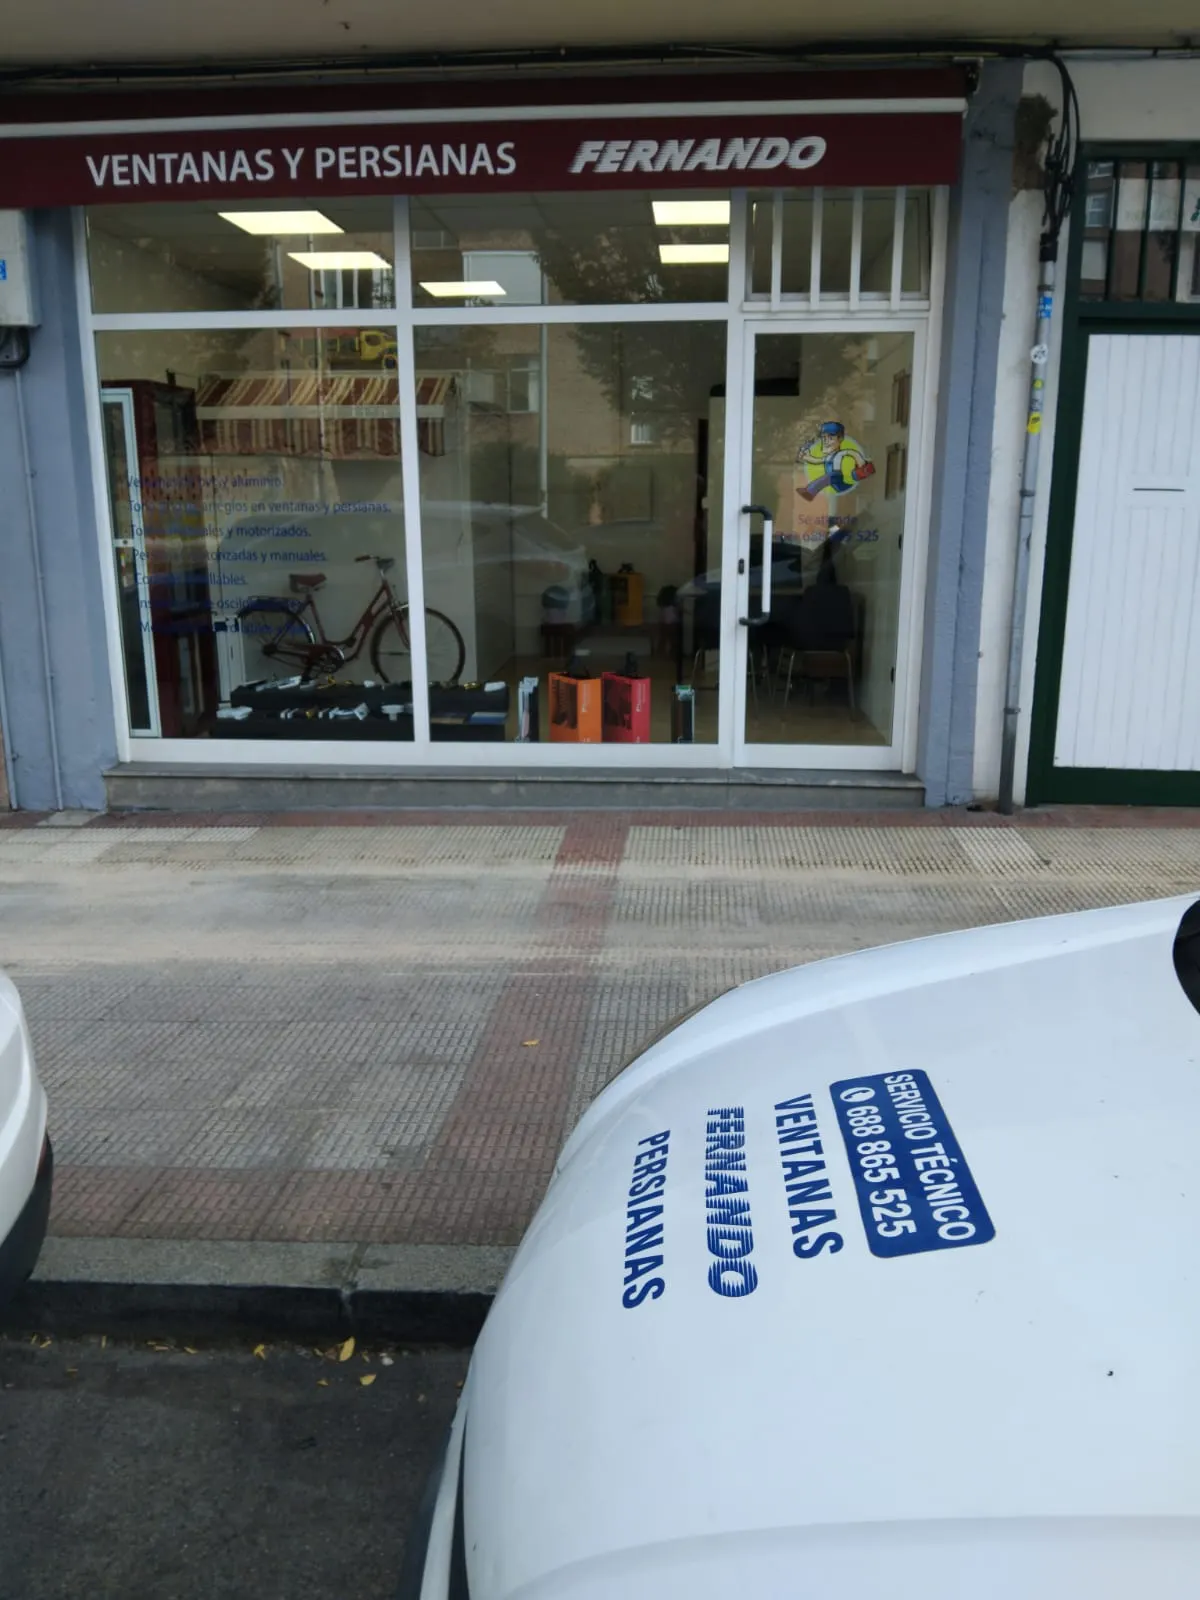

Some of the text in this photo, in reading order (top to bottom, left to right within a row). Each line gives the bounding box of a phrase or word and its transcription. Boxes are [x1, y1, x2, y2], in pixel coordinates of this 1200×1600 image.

[86, 141, 517, 188] VENTANAS Y PERSIANAS
[567, 135, 827, 175] FERNANDO
[227, 526, 234, 540] y
[236, 524, 312, 537] motorizados.
[251, 502, 265, 512] en
[268, 501, 322, 512] ventanas
[260, 551, 267, 563] y
[705, 1106, 758, 1297] FERNANDO
[774, 1093, 844, 1260] VENTANAS
[846, 1105, 918, 1239] 688 865 525
[884, 1072, 976, 1242] SERVICIO TÉCNICO
[622, 1129, 671, 1309] PERSIANAS
